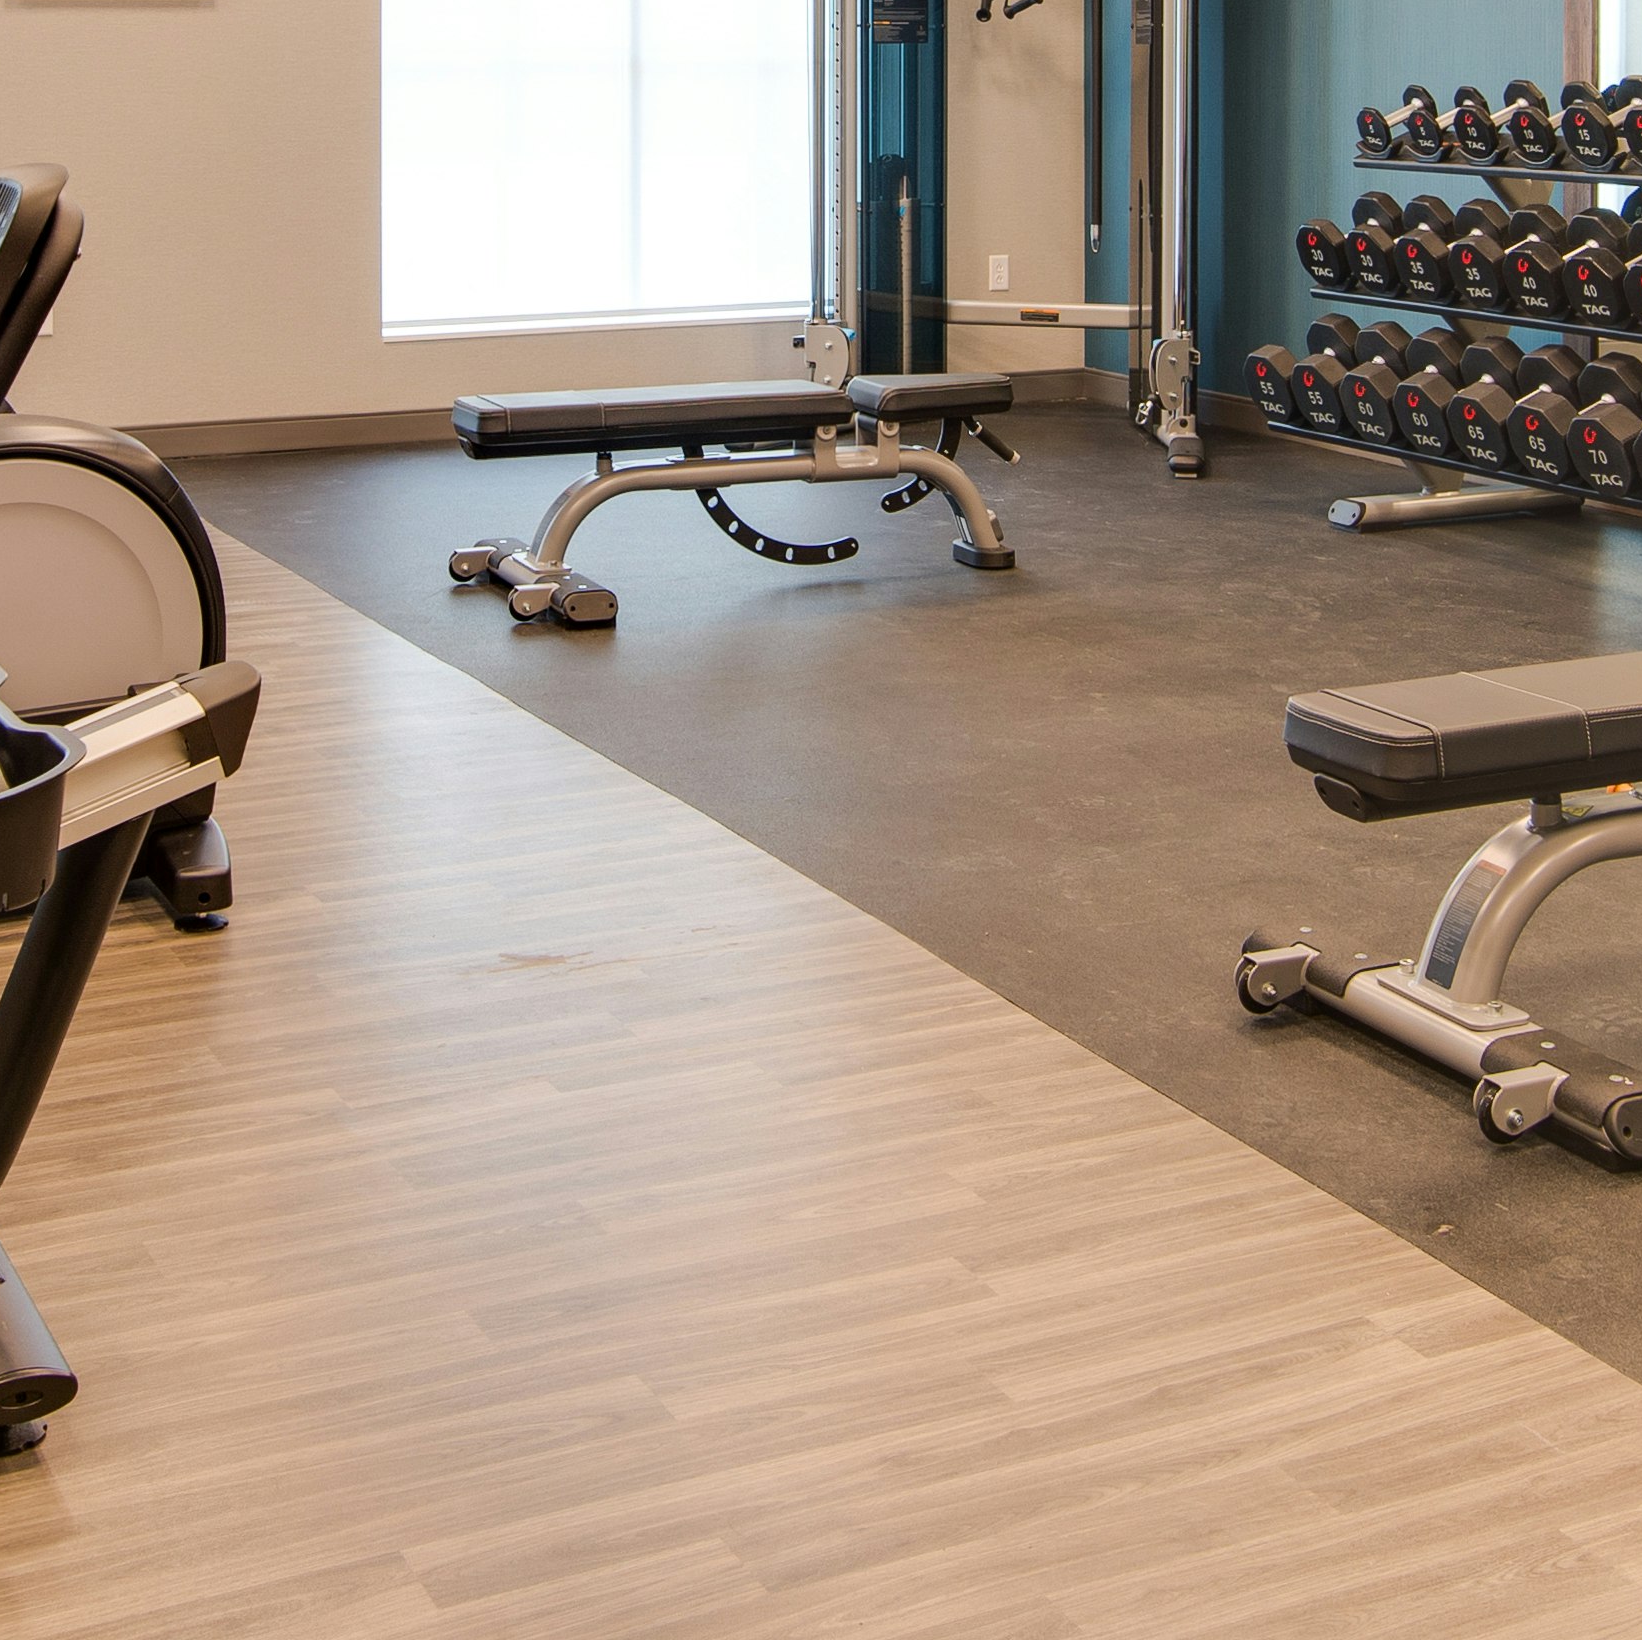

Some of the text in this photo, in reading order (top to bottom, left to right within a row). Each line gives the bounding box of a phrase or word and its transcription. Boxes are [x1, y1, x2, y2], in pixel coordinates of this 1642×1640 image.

[1467, 127, 1477, 136] 10
[1524, 130, 1534, 139] 10
[1579, 130, 1590, 140] 15
[1366, 137, 1382, 145] TAG
[1466, 141, 1485, 150] TAG
[1523, 145, 1543, 153] TAG
[1576, 146, 1600, 156] TAG
[1312, 249, 1323, 261] 30
[1361, 255, 1373, 266] 30
[1311, 267, 1333, 277] TAG
[1411, 262, 1424, 274] 35
[1466, 268, 1480, 280] 35
[1361, 272, 1383, 283] TAG
[1523, 277, 1536, 289] 40
[1410, 280, 1434, 291] TAG
[1584, 285, 1597, 297] 40
[1467, 288, 1492, 297] TAG
[1521, 296, 1548, 307] TAG
[1582, 304, 1610, 315] TAG
[1260, 382, 1274, 395] 55
[1308, 392, 1323, 405] 55
[1261, 401, 1285, 414] TAG
[1358, 402, 1373, 416] 60
[1310, 412, 1335, 423] TAG
[1413, 413, 1428, 426] 60
[1358, 421, 1385, 437] TAG
[1468, 425, 1484, 440] 65
[1413, 434, 1441, 447] TAG
[1529, 436, 1546, 452] 65
[1467, 446, 1497, 462] TAG
[1589, 450, 1607, 464] 70
[1526, 456, 1558, 475] TAG
[1591, 474, 1623, 486] TAG
